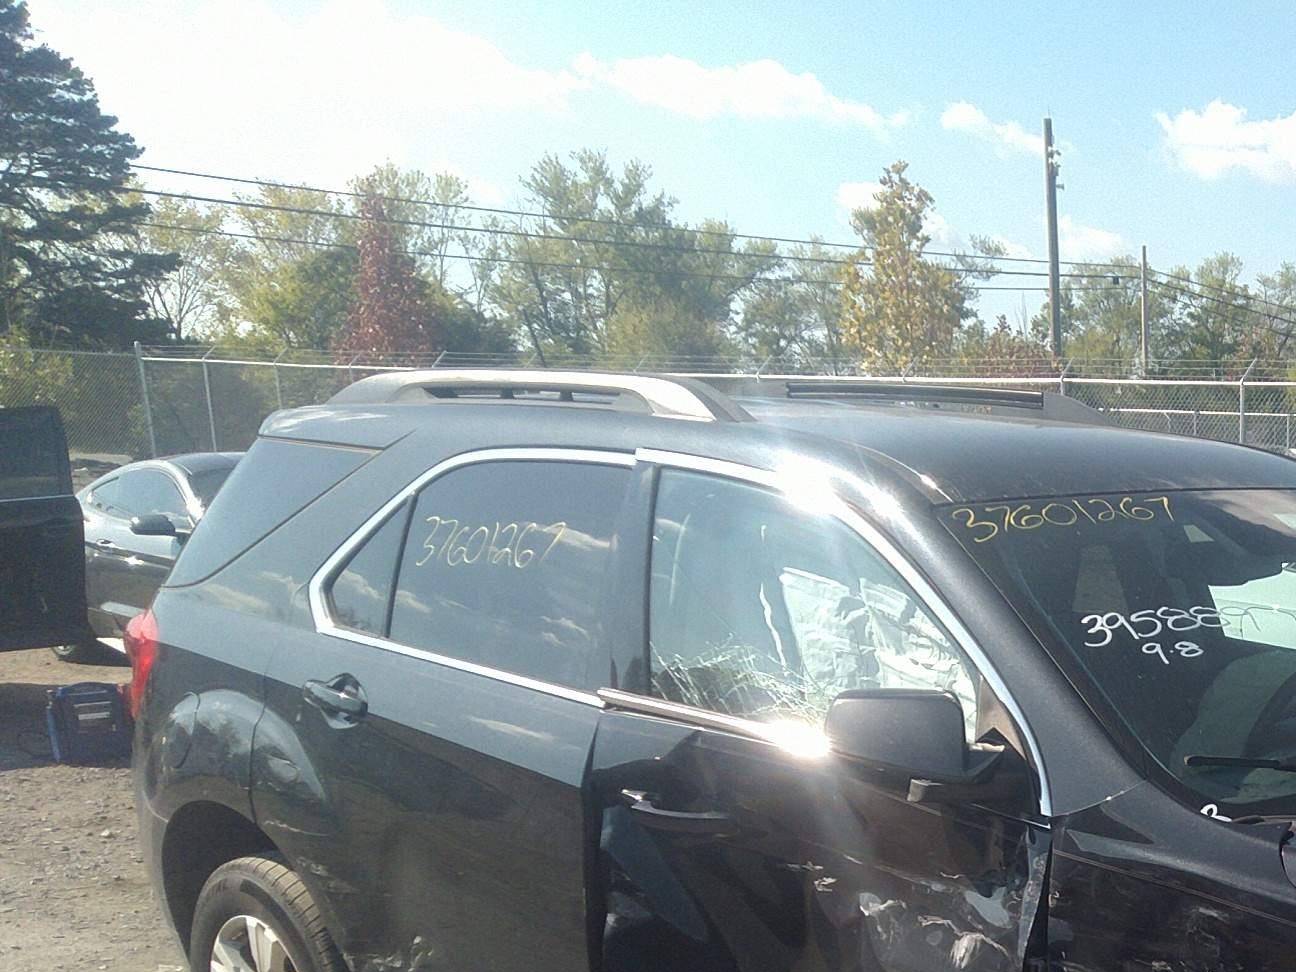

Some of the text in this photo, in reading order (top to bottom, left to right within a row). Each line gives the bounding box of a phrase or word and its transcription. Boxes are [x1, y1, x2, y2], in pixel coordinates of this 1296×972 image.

[415, 515, 567, 569] 37601267
[952, 496, 1176, 543] 37601267
[1141, 640, 1204, 665] 9.8
